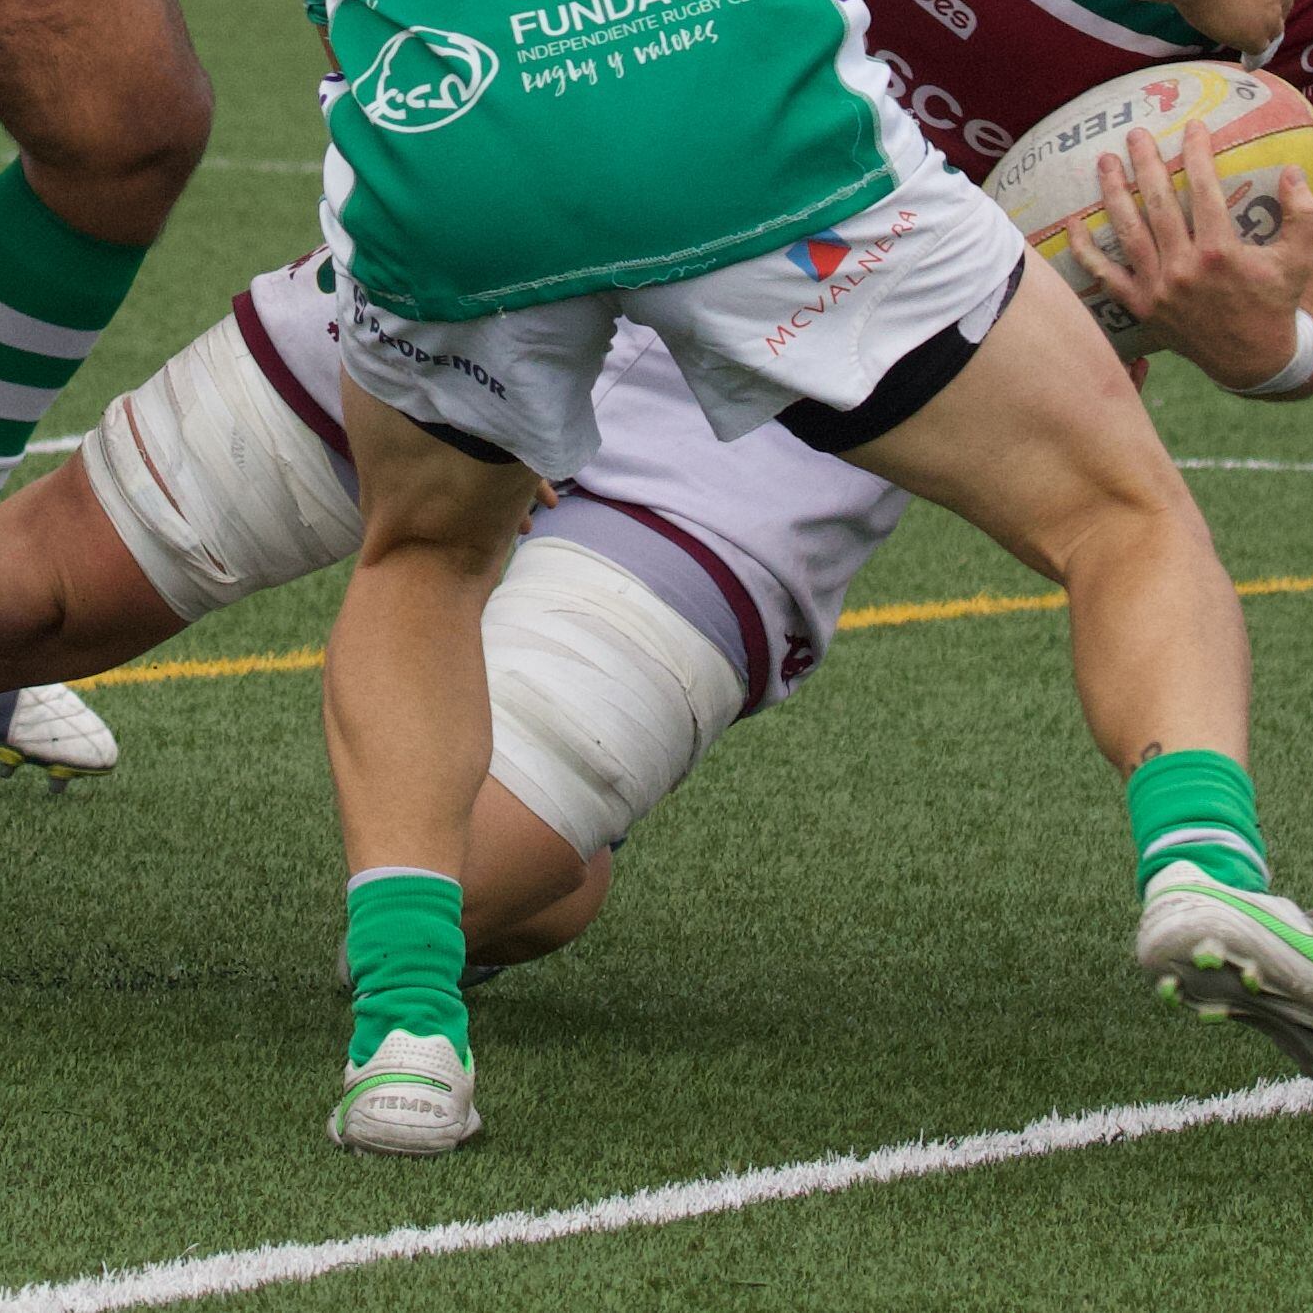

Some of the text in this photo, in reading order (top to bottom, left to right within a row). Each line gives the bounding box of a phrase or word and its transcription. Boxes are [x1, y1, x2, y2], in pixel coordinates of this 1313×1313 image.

[515, 14, 660, 65] INDEPENDIENTE
[606, 50, 625, 79] y
[990, 100, 1134, 201] FERugby
[765, 209, 918, 356] MCVALNERA
[369, 316, 507, 401] PROPENOR
